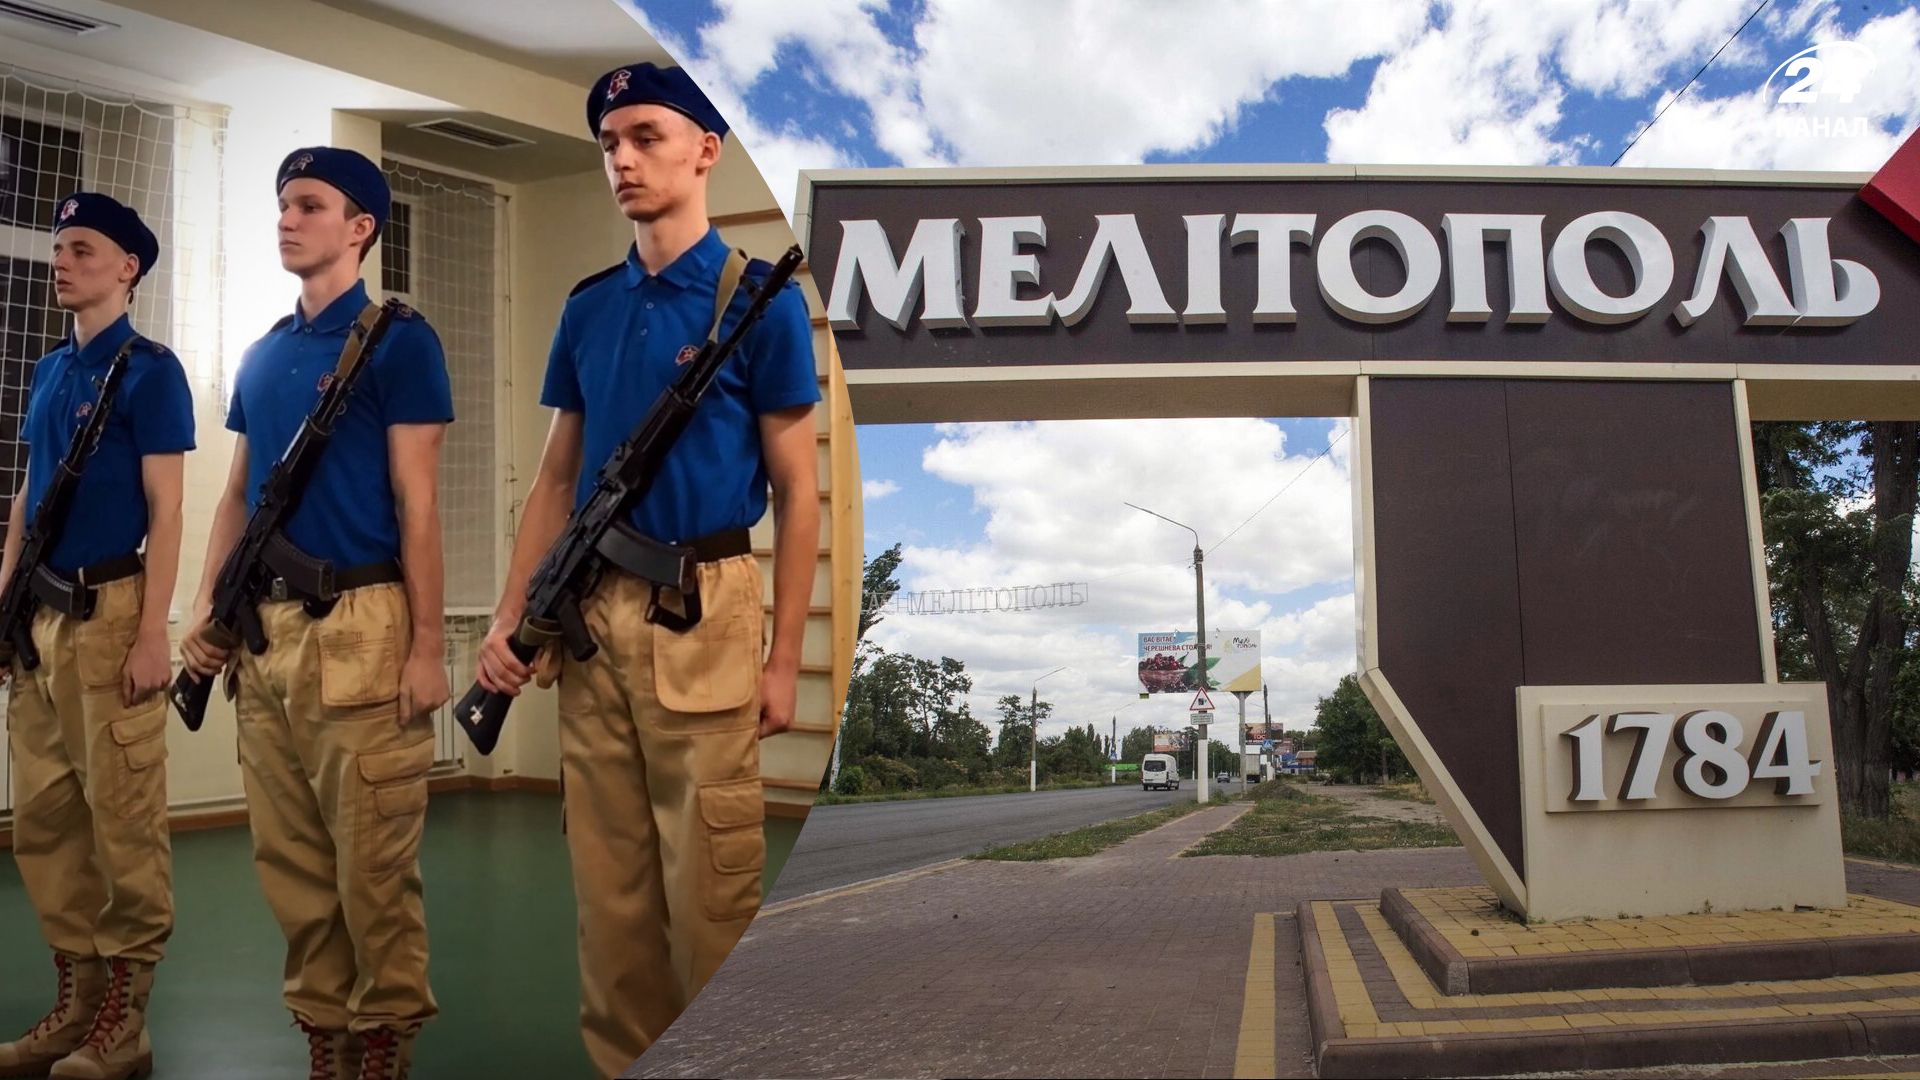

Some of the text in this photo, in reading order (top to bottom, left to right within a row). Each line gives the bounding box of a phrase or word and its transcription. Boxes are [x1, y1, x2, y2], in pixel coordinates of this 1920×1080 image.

[826, 209, 1882, 331] МЕЛІТОПОЛЬ
[908, 583, 1087, 616] МЕЛІТОПОЛЬ
[1560, 710, 1822, 800] 1784
